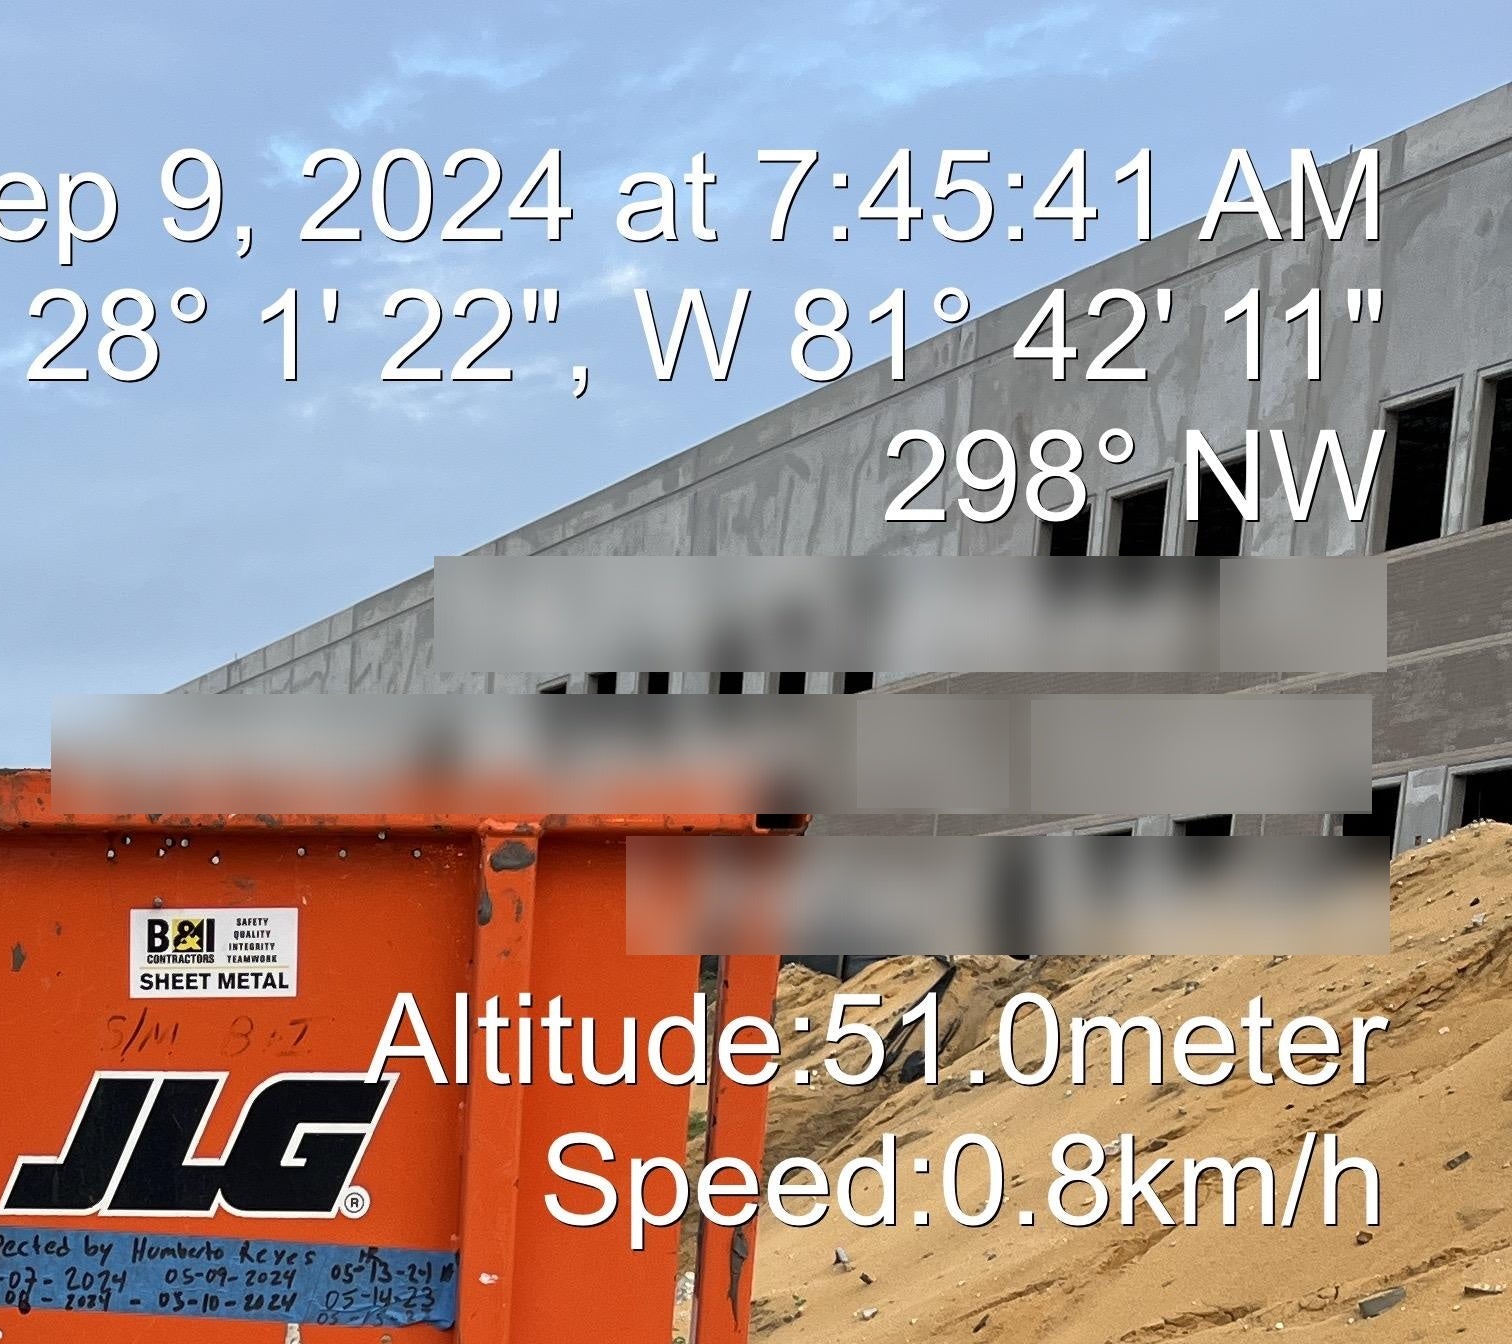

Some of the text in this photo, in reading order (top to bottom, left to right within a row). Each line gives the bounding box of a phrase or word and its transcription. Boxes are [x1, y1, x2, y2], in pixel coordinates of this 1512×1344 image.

[236, 917, 270, 926] SAFETY
[147, 918, 215, 953] B&I
[233, 929, 271, 939] QUALITY
[228, 942, 276, 951] INTEGRITY
[146, 953, 216, 964] CONTRACTORS
[226, 954, 278, 963] TEAMWORK
[139, 972, 290, 991] SHEET METAL
[83, 1234, 114, 1266] by
[131, 1236, 225, 1264] Humberto
[238, 1239, 317, 1267] Reyes
